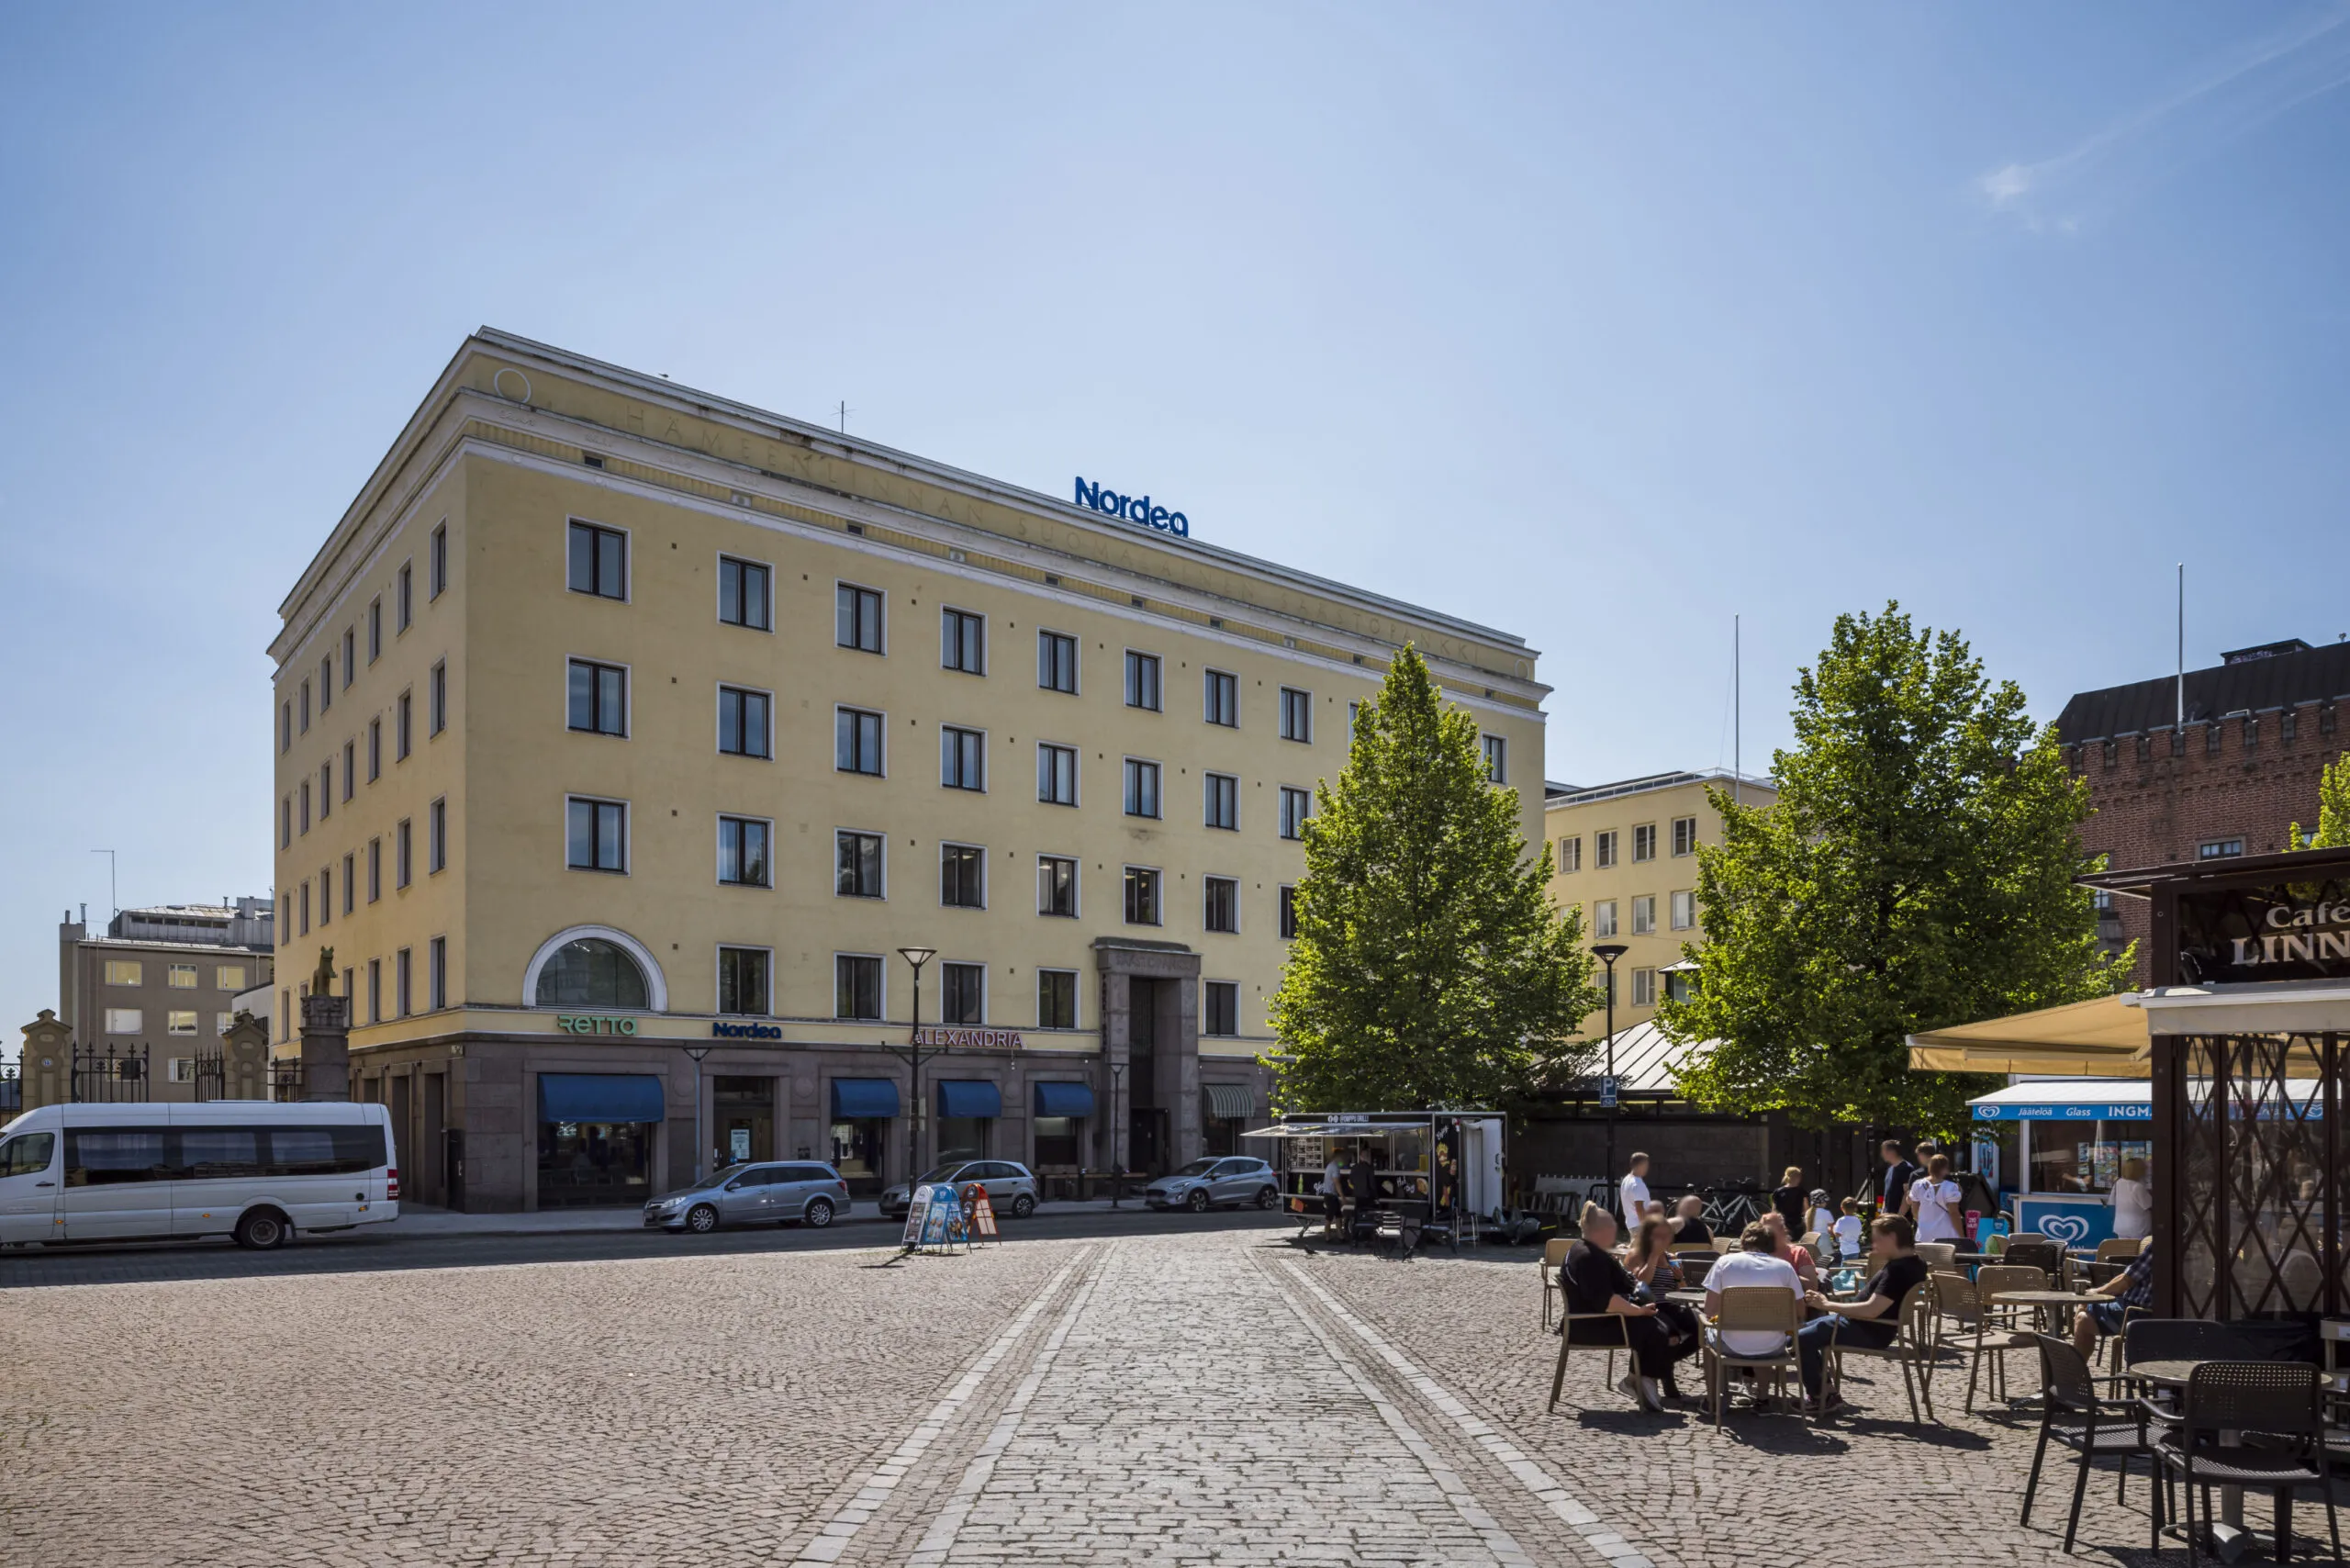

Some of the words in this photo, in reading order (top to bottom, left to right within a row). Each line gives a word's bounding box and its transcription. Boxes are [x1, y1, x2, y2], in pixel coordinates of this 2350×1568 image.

[1075, 476, 1189, 538] Nordea
[2266, 898, 2350, 928] Café
[712, 1022, 782, 1039] Nordea
[1603, 1077, 1614, 1095] P
[2065, 1107, 2091, 1116] Glass
[2108, 1105, 2152, 1117] INGM
